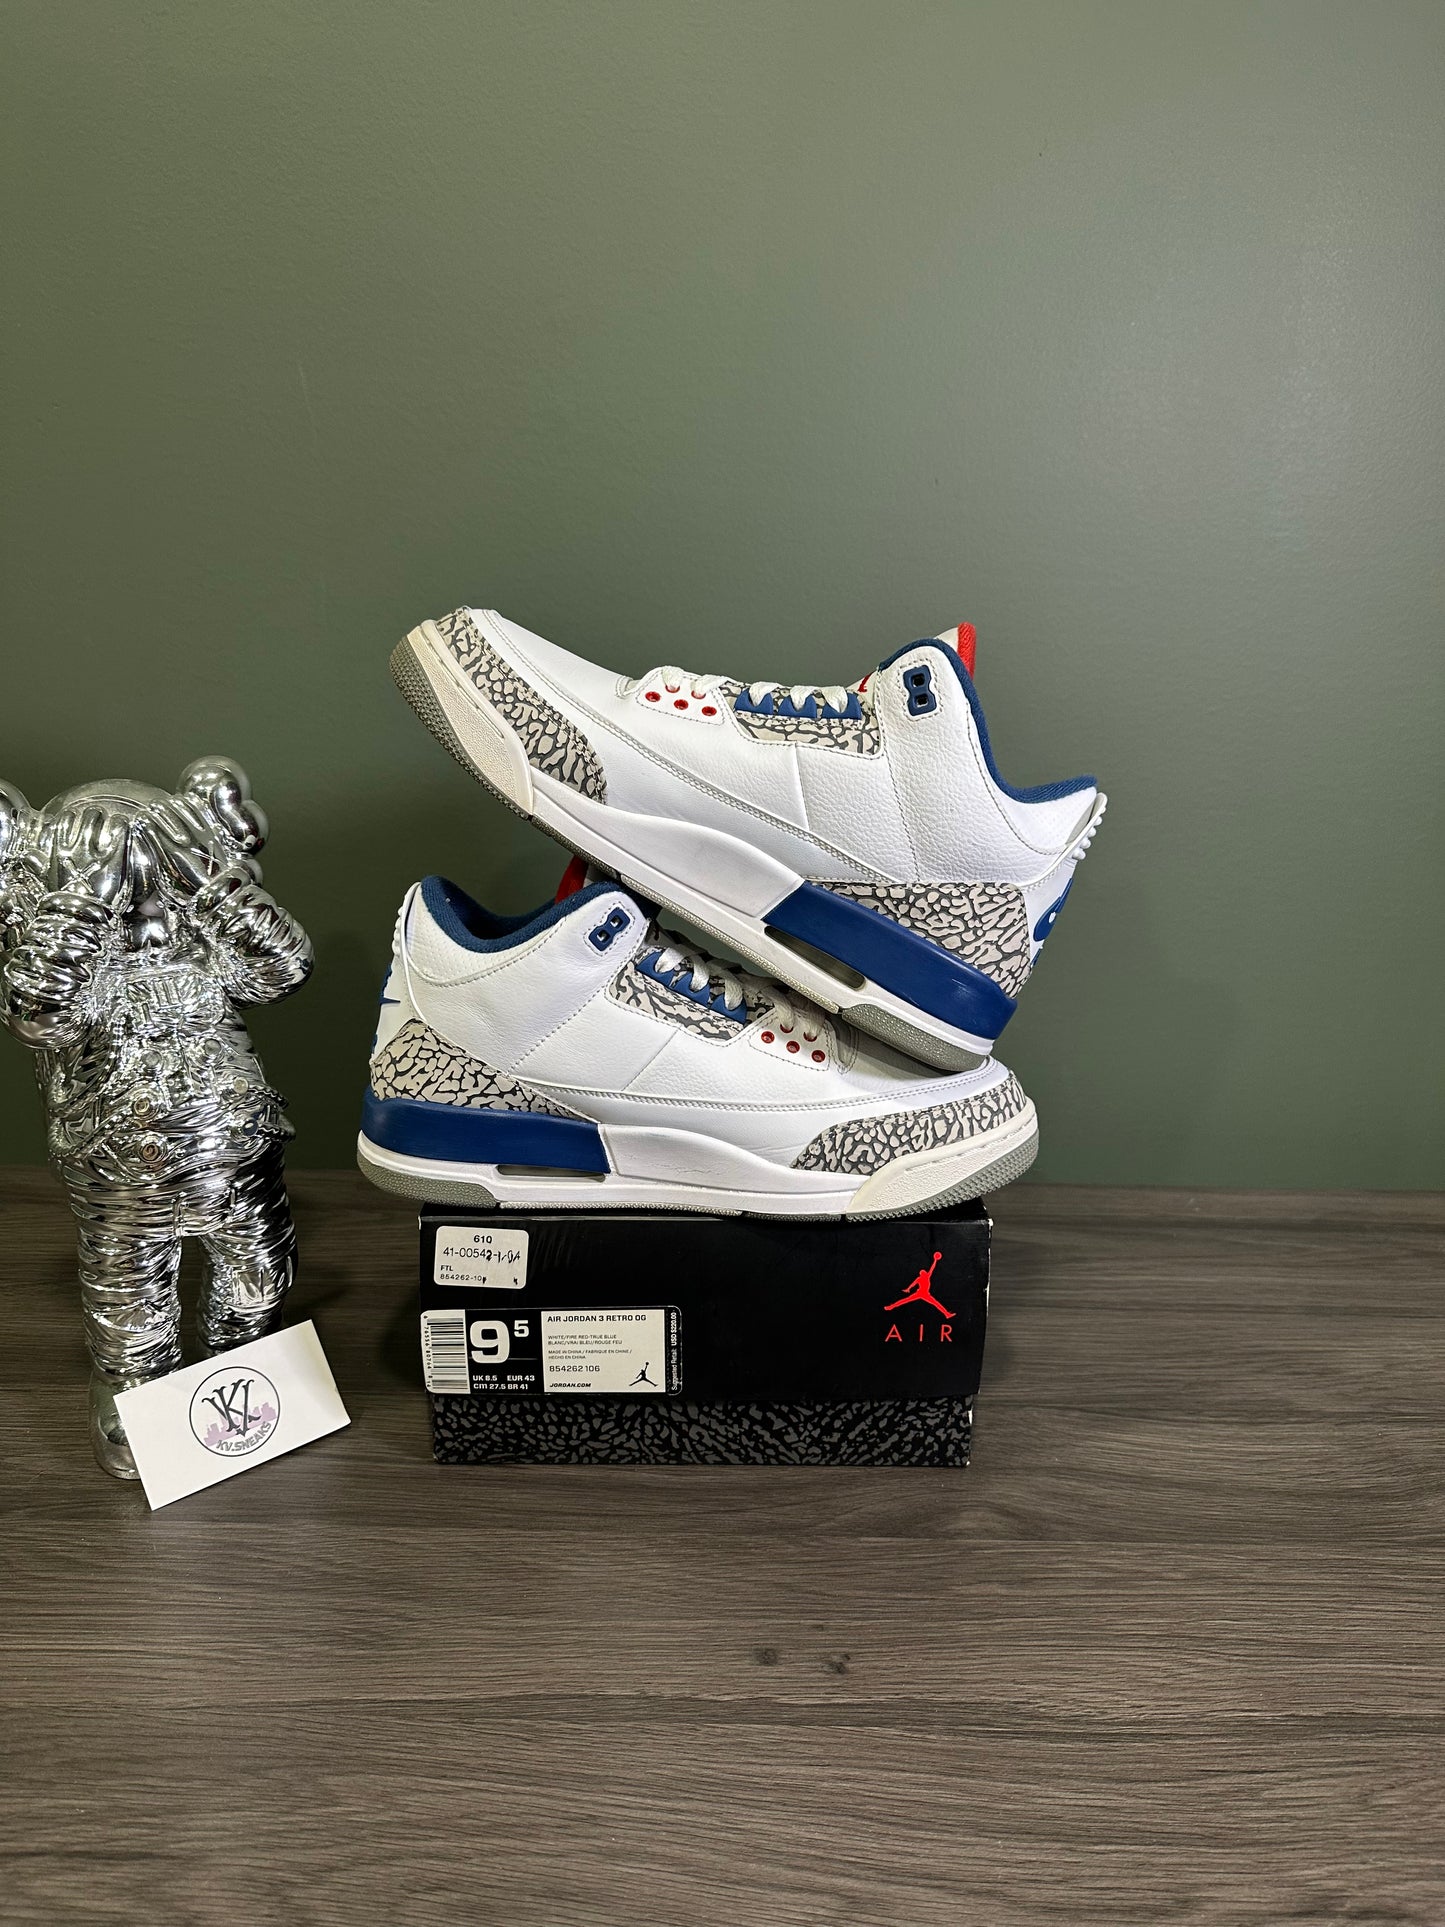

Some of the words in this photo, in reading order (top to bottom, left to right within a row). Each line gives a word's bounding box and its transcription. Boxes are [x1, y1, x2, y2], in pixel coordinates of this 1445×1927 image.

[470, 1320, 510, 1364] 9
[514, 1320, 529, 1337] 5
[885, 1323, 953, 1342] AIR
[216, 1421, 272, 1452] KV.SNEAKS
